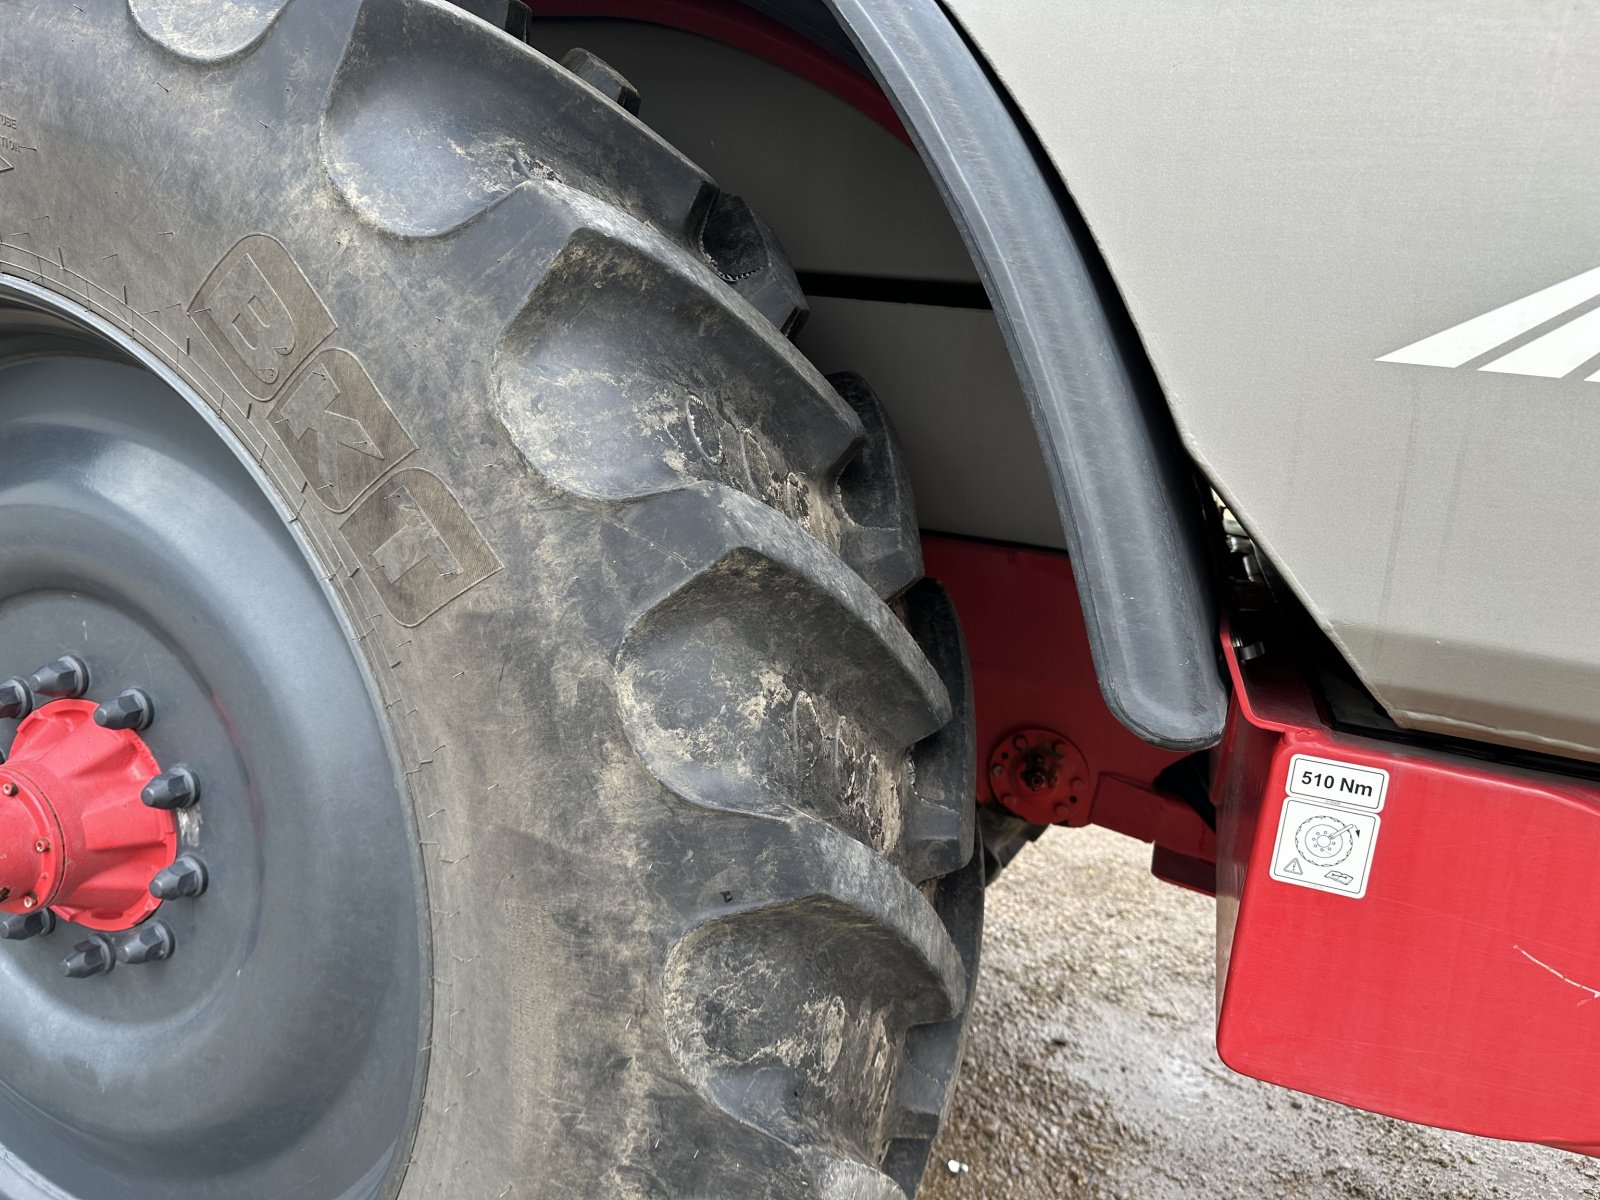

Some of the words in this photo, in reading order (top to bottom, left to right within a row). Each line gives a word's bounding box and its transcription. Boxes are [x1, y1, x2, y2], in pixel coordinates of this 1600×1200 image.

[200, 248, 468, 588] BKT
[1301, 771, 1335, 789] 510
[1339, 777, 1373, 797] Nm
